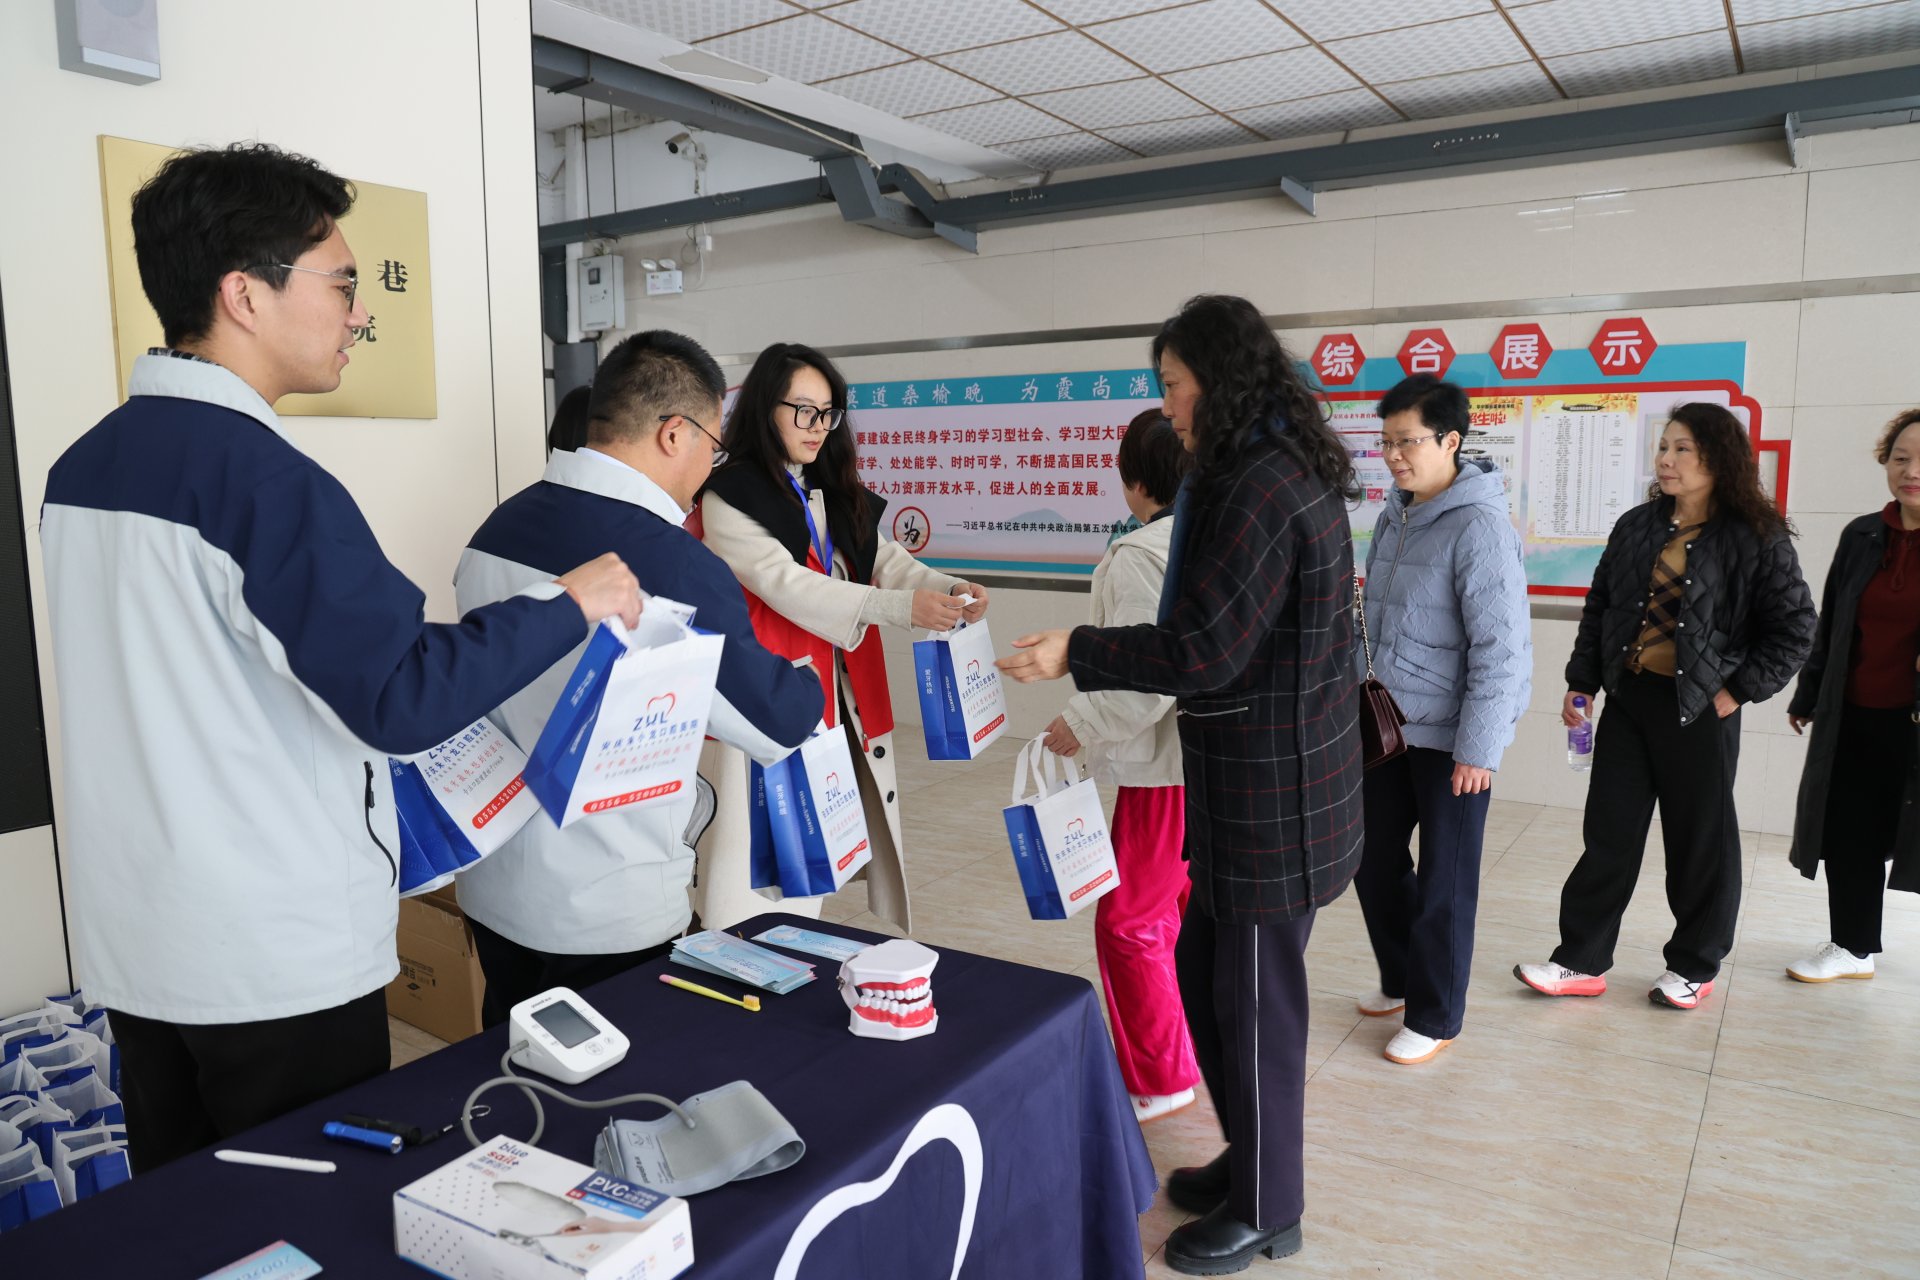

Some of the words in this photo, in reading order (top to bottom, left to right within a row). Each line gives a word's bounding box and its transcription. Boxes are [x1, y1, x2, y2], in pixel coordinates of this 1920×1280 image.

[377, 259, 409, 293] 巷
[1321, 330, 1643, 378] 综合展示
[846, 382, 984, 409] 莫道桑榆晚
[1020, 373, 1150, 402] 为霞尚满
[856, 425, 1128, 446] 要建设全民终身学习的学习型社会、学习型大国
[477, 777, 523, 824] 0556-52000
[487, 1151, 516, 1165] sail
[499, 1142, 528, 1158] blue
[588, 1176, 629, 1197] PVC
